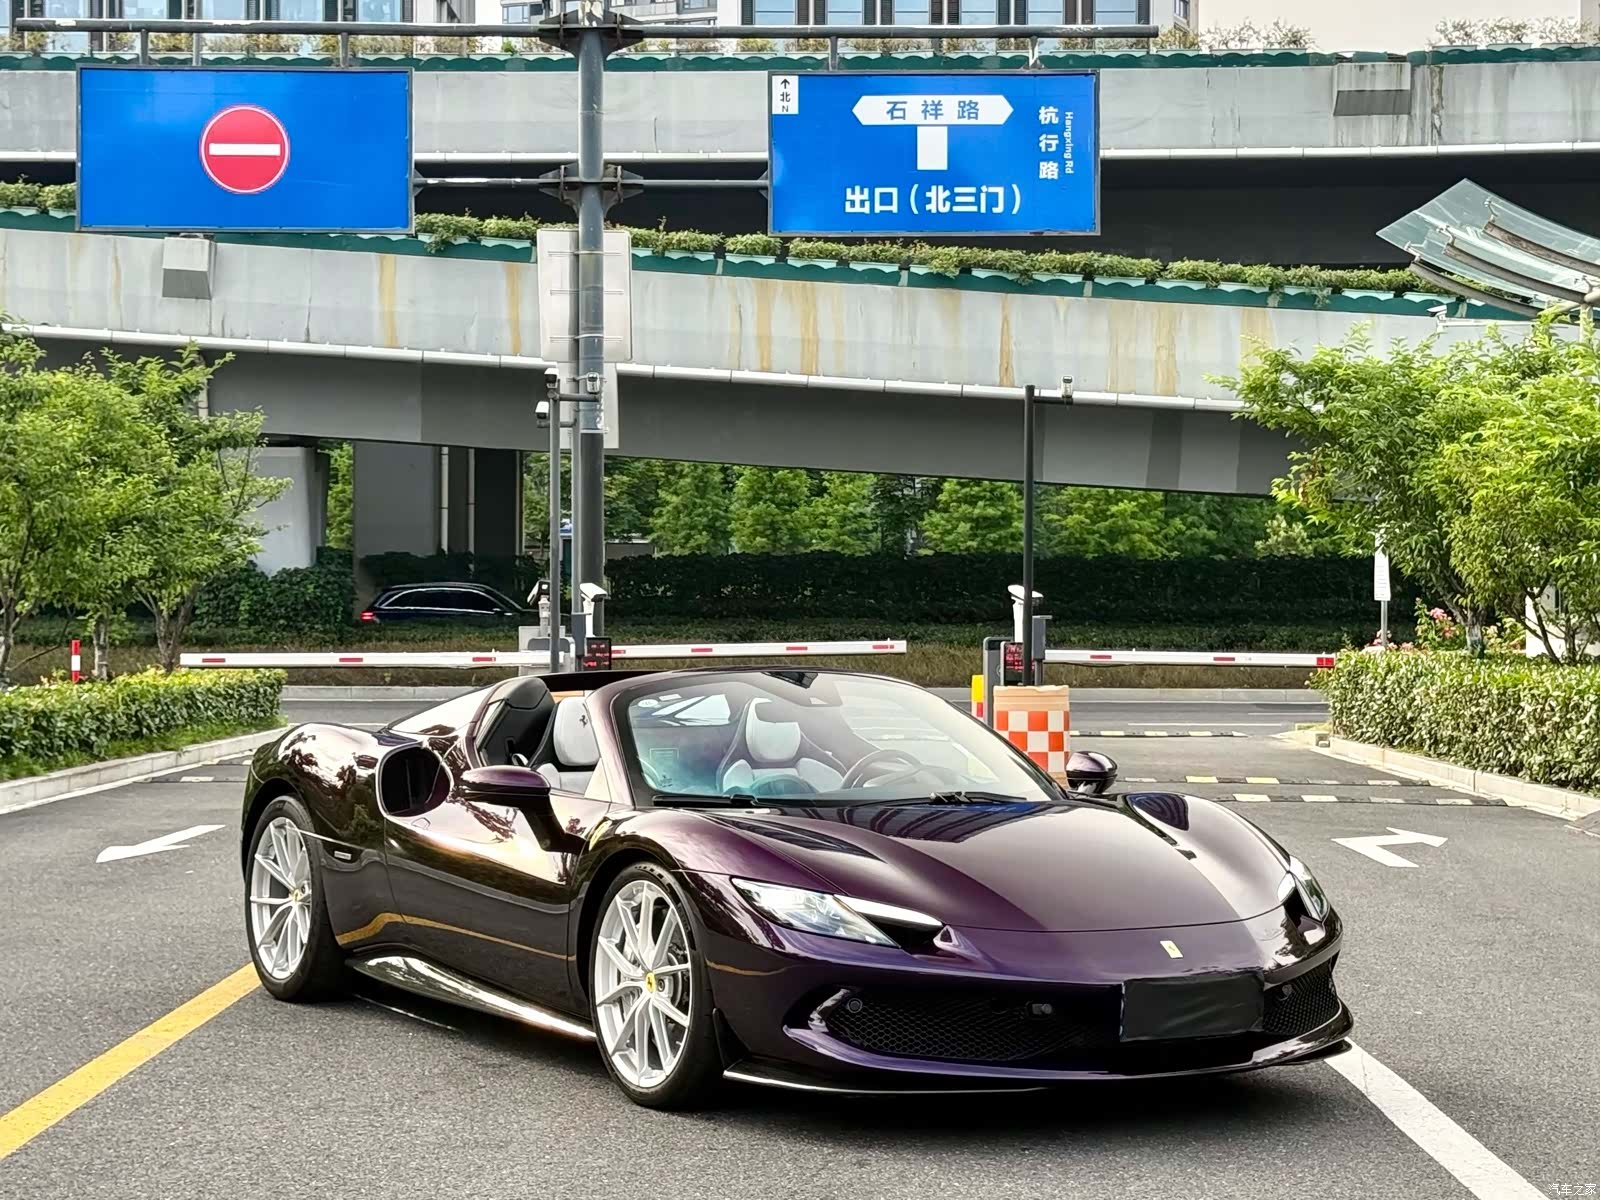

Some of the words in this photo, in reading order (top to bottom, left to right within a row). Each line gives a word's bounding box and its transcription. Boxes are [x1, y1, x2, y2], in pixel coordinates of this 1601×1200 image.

[779, 91, 791, 103] 北
[781, 104, 789, 113] N
[886, 100, 980, 121] 石祥路
[1038, 106, 1059, 179] 杭行路
[1063, 111, 1074, 159] Hangxing
[1064, 160, 1075, 174] Rd
